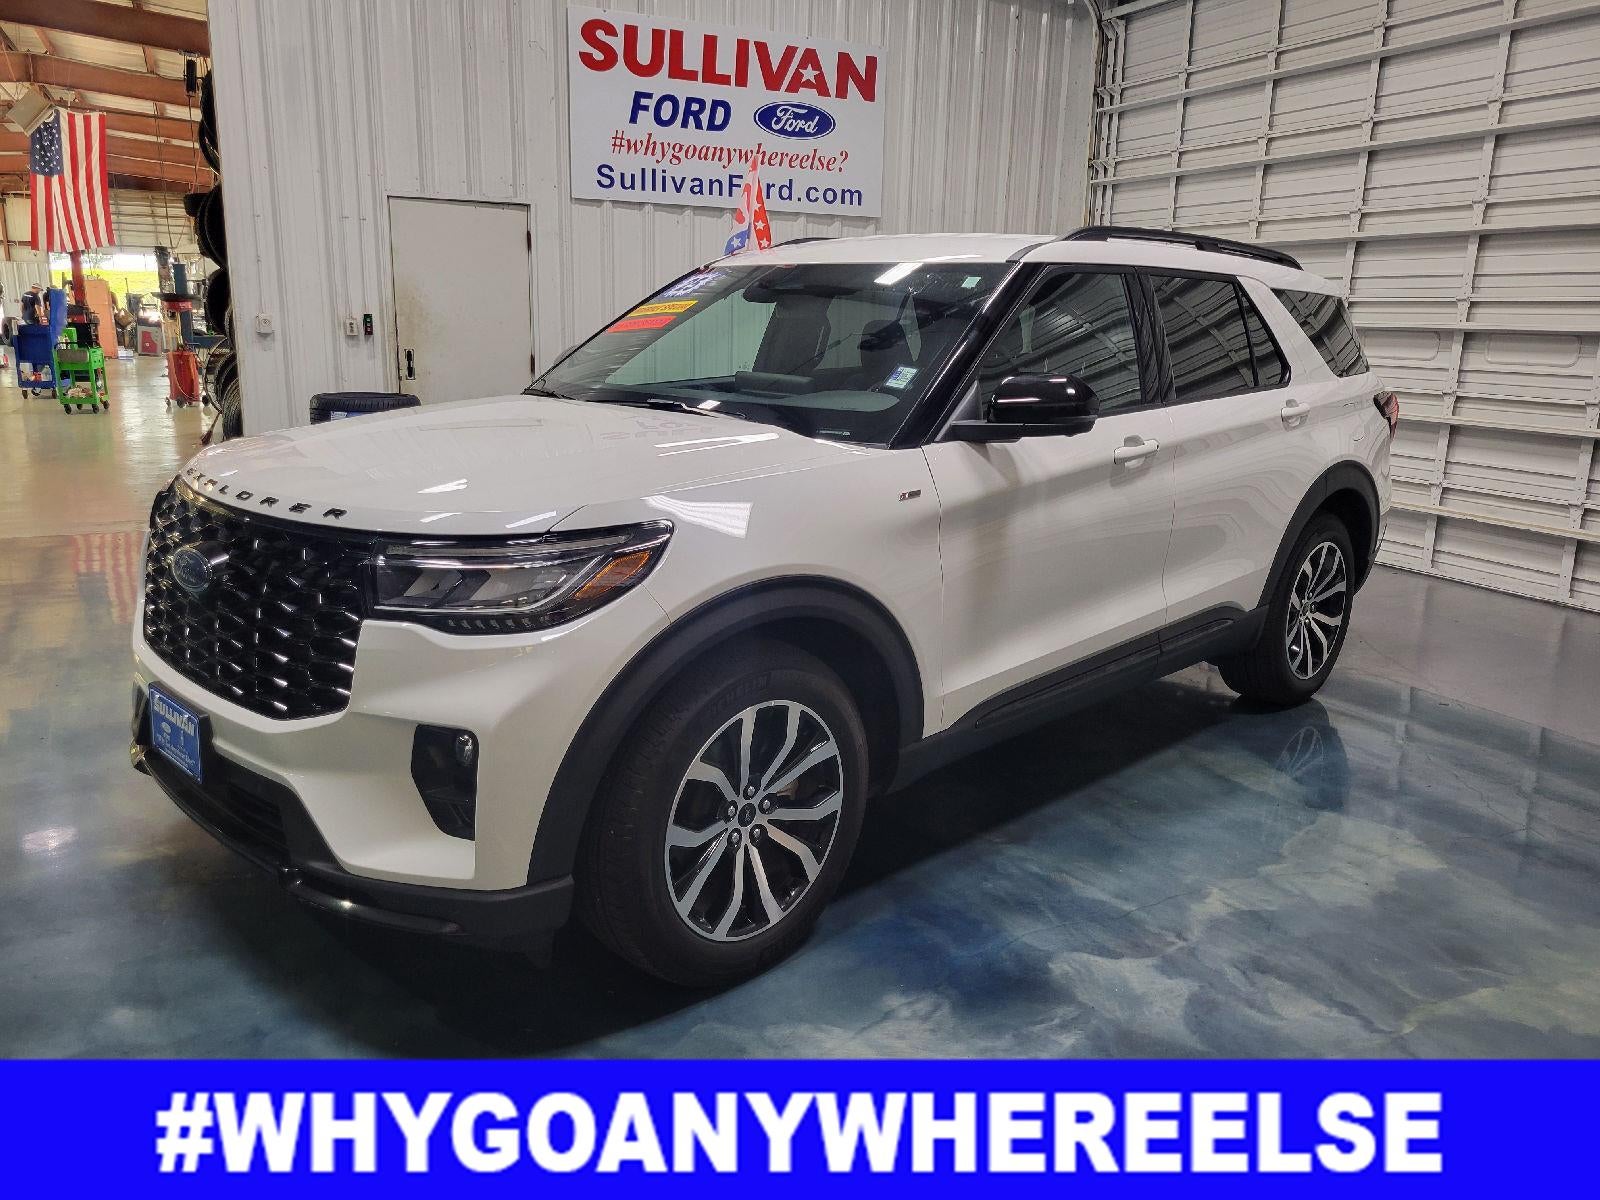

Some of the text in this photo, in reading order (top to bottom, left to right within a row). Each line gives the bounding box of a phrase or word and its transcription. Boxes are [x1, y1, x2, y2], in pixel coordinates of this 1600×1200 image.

[579, 19, 878, 102] SULLIVAN
[629, 91, 732, 132] FORD
[771, 105, 819, 134] Ford
[611, 129, 849, 173] #whygoanywhereelse?
[596, 164, 863, 206] SullivanFrd.com
